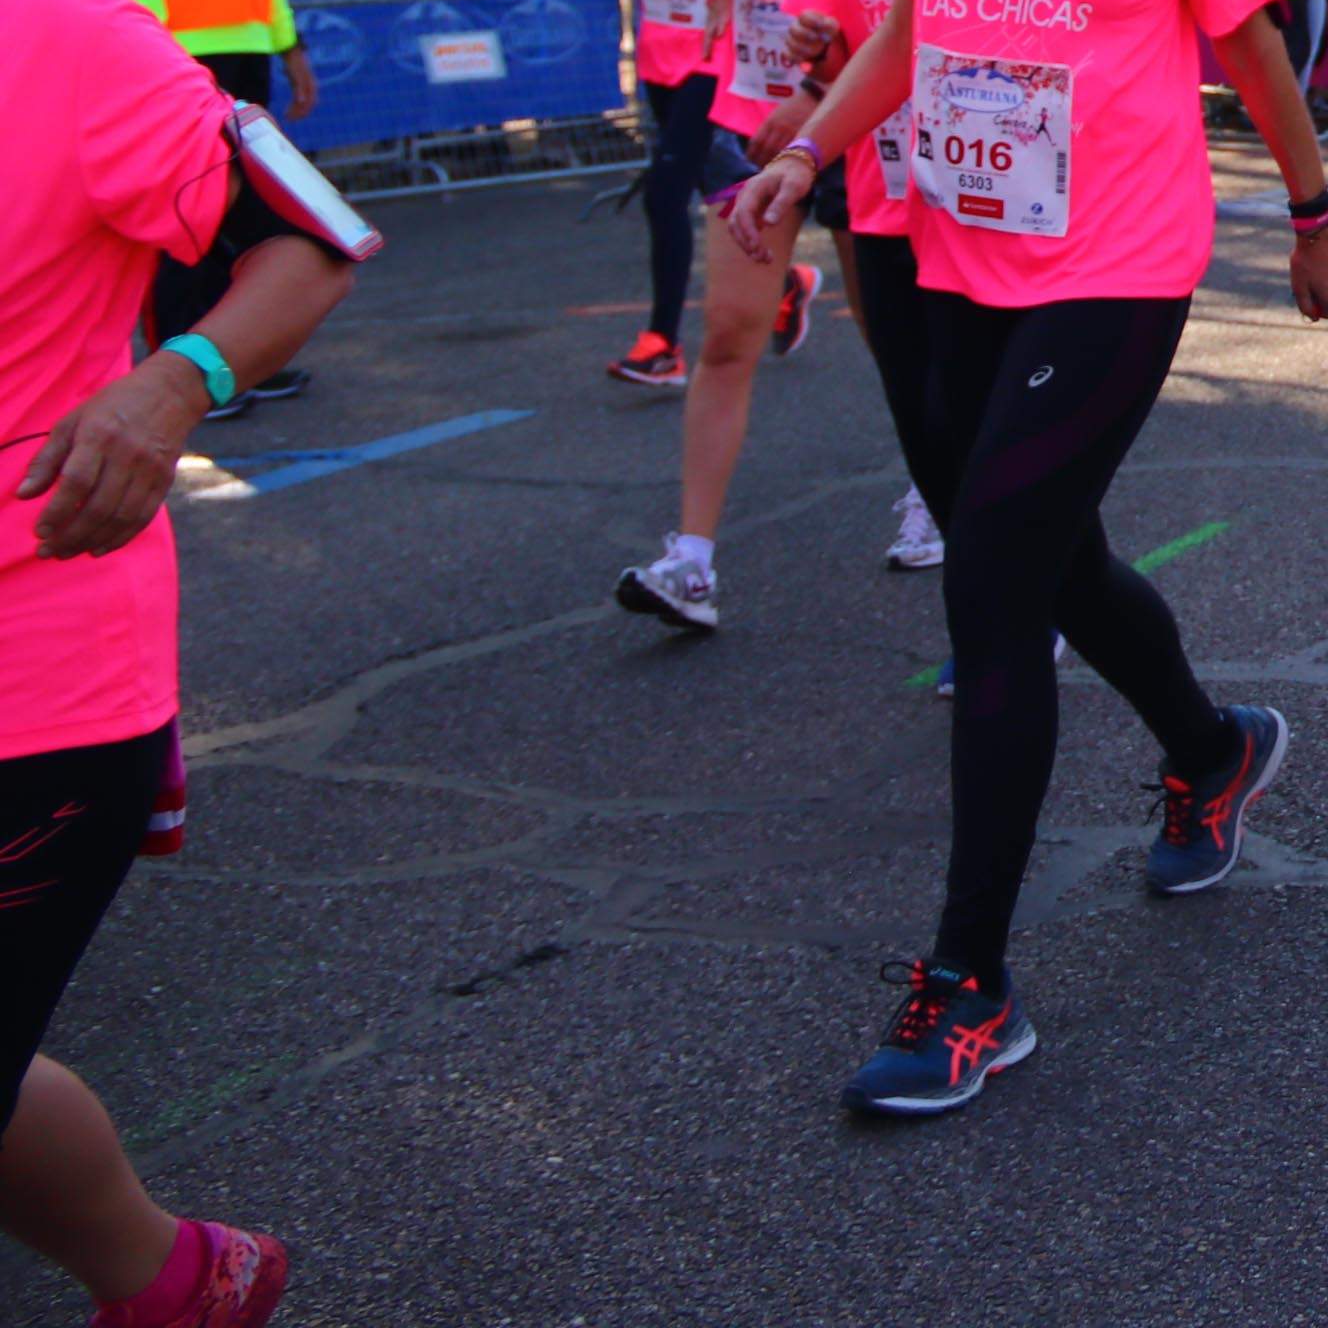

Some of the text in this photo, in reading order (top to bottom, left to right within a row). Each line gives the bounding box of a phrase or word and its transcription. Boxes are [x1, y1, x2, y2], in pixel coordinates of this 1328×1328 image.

[944, 82, 1018, 105] ASTURIANA
[944, 135, 1013, 171] 016
[958, 174, 993, 192] 6303
